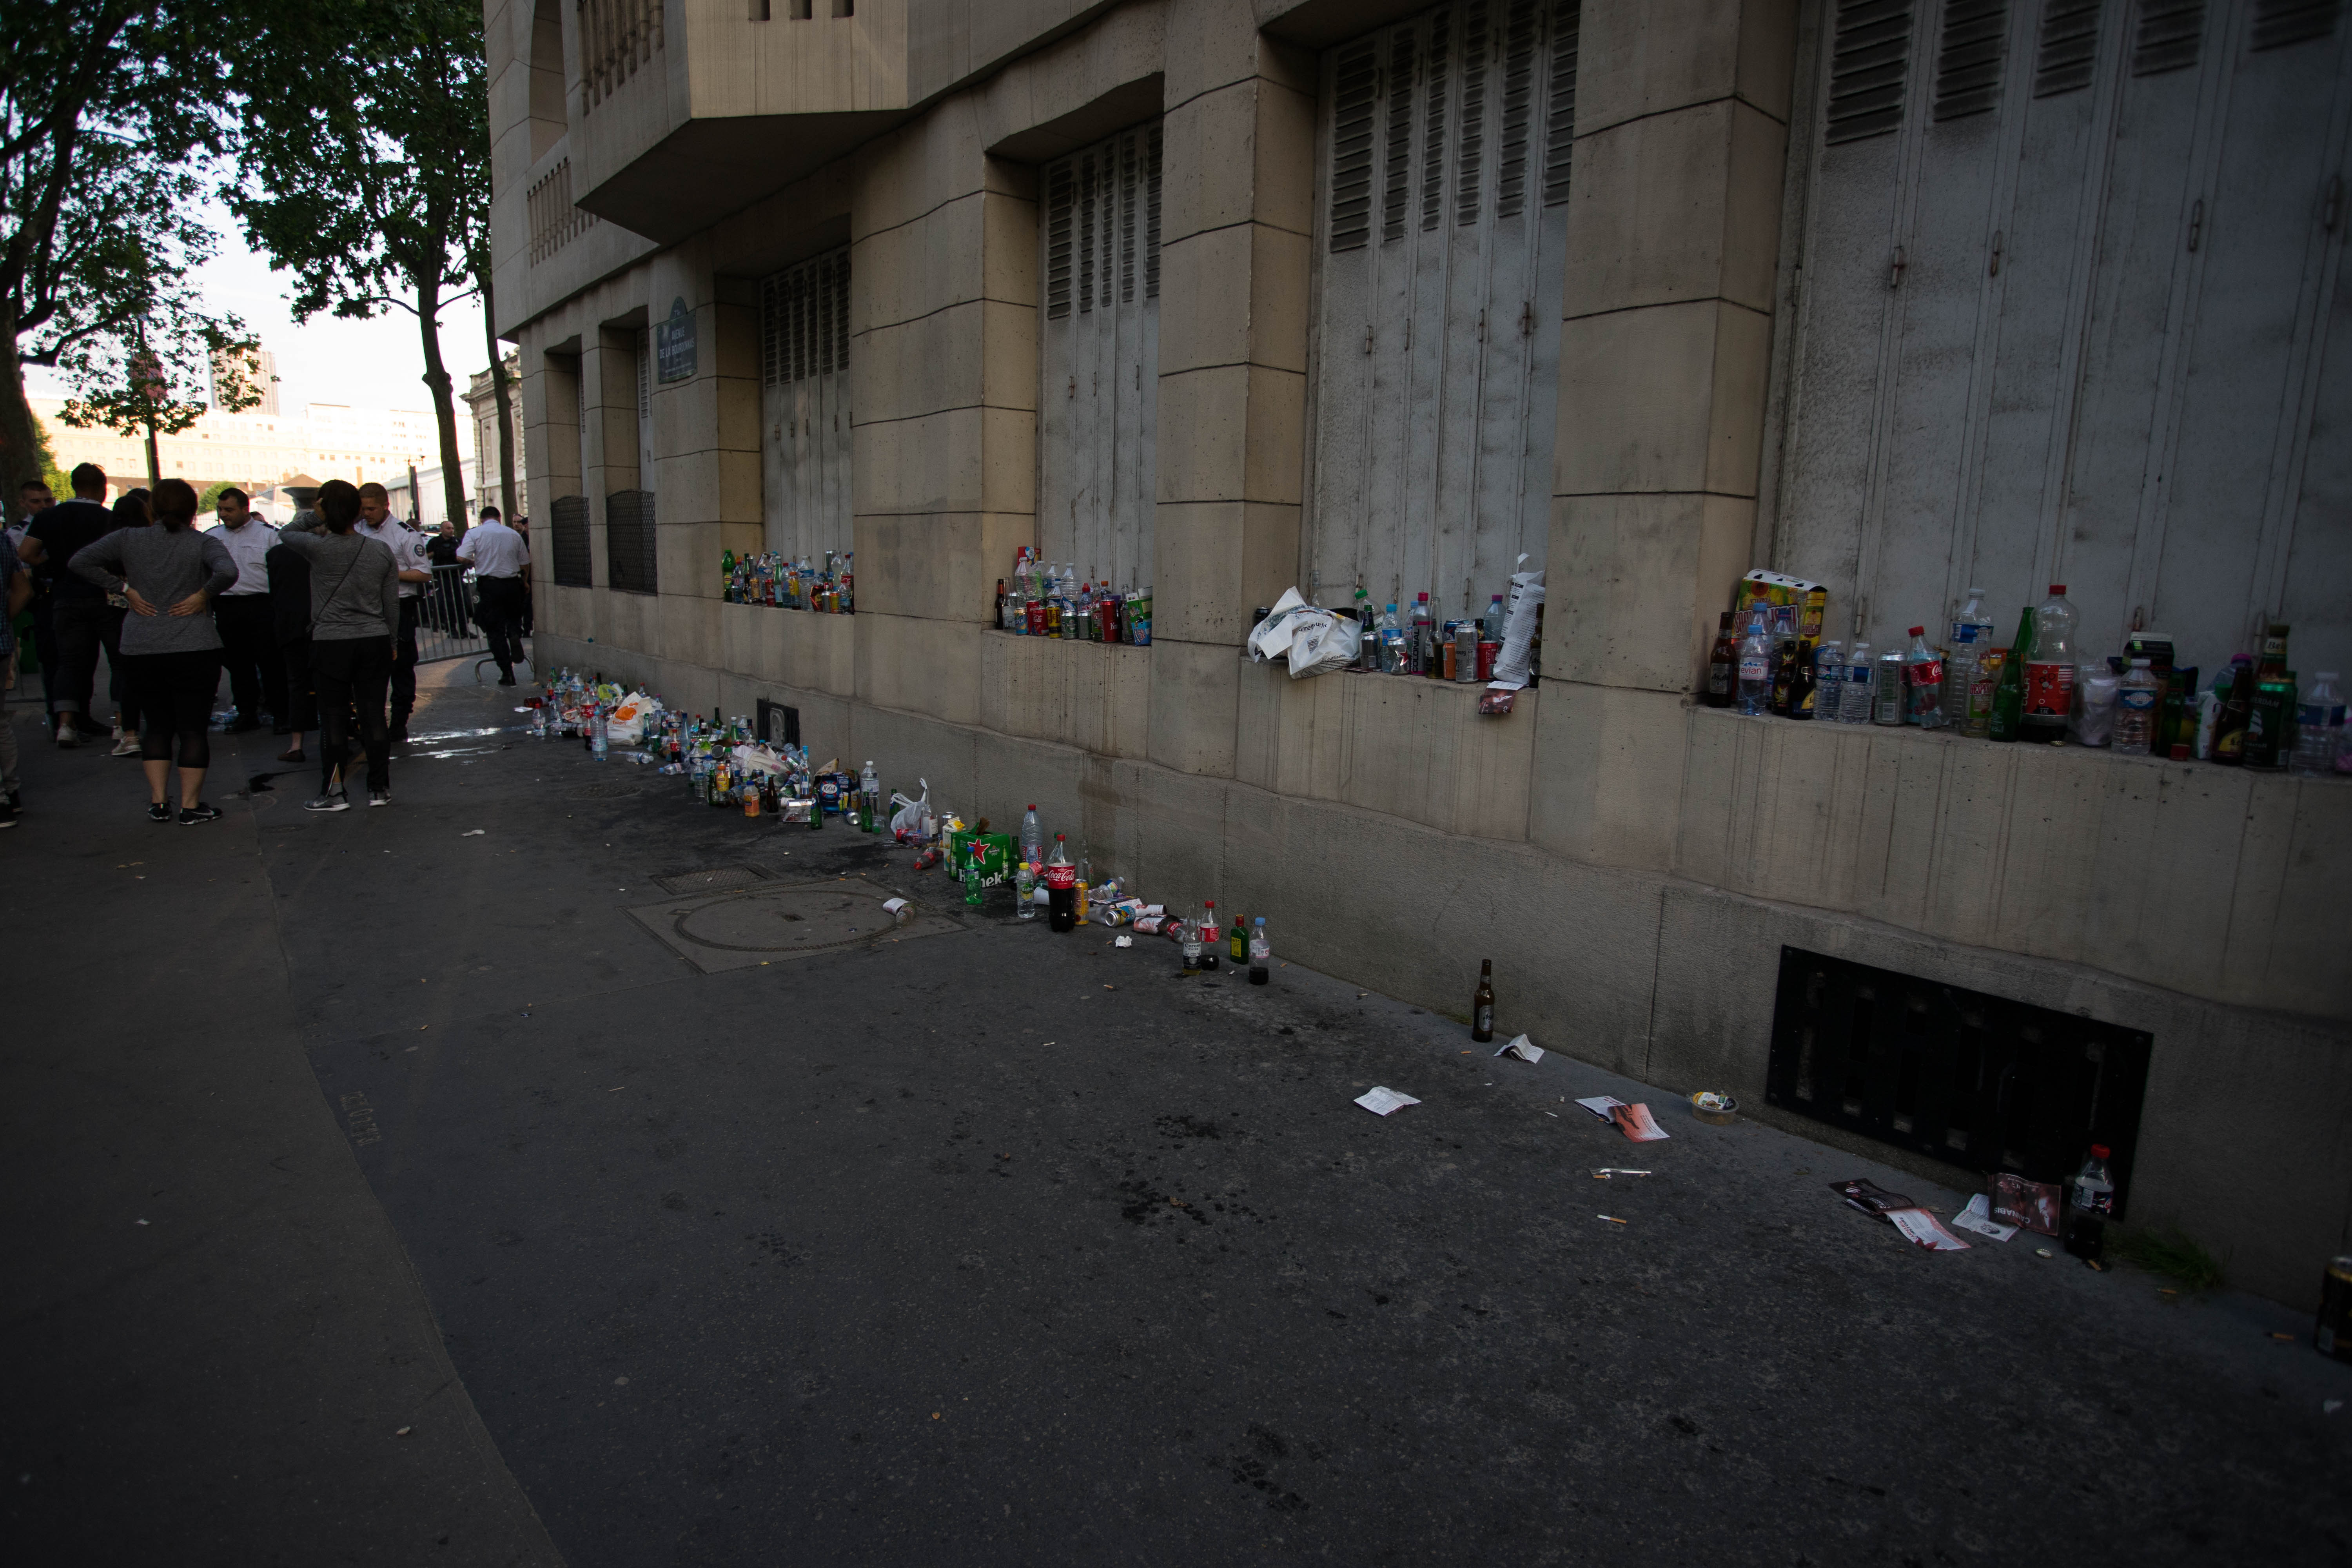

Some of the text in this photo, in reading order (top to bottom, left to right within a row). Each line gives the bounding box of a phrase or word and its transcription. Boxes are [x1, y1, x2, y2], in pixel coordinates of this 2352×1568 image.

[671, 326, 685, 341] AVENUE
[659, 338, 694, 359] DE LA BOURDONNAIS
[1049, 869, 1075, 882] Coca-Cola
[1994, 1207, 2031, 1224] CANNABIS
[1898, 1221, 1917, 1240] CANNABIS
[1899, 1217, 1916, 1236] HISTOIRE
